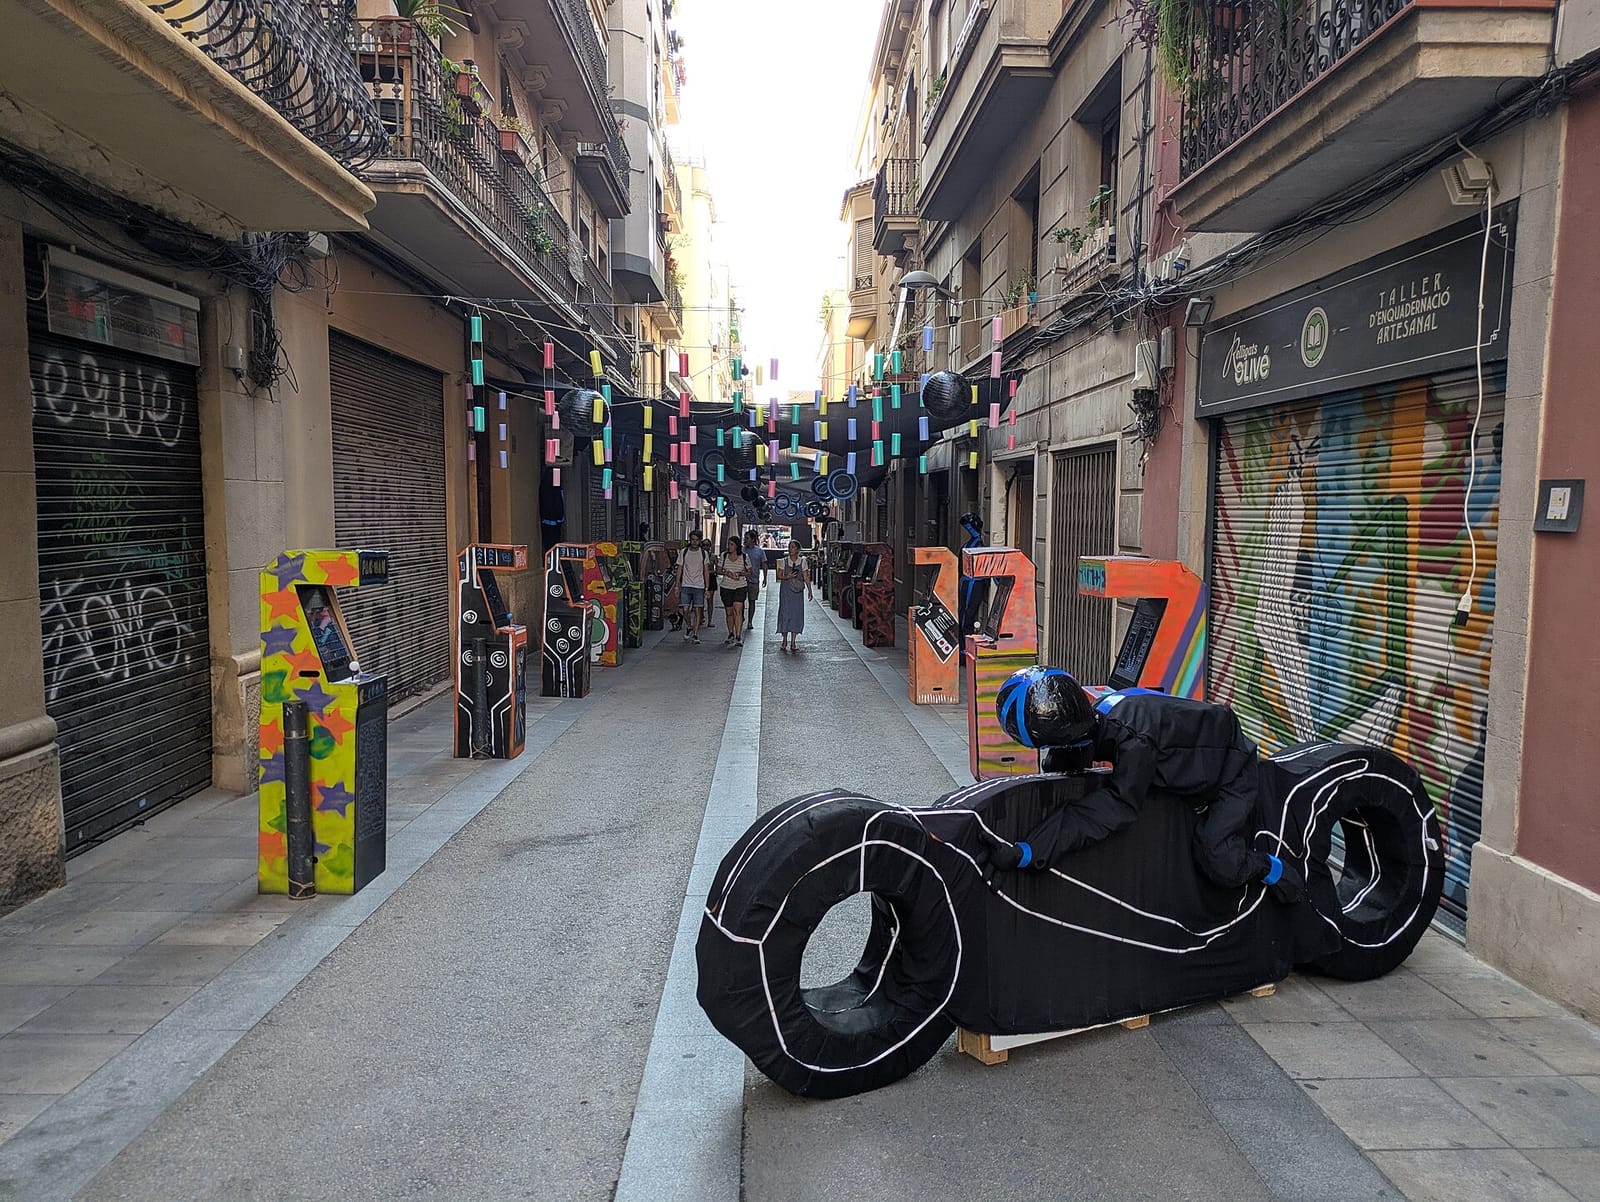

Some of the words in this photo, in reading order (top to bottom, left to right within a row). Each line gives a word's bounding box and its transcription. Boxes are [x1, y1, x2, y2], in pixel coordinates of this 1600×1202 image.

[1369, 286, 1450, 328] D'ENQUADERNACIÓ
[1379, 272, 1441, 308] TALLER
[1376, 312, 1439, 345] ARTESANAL
